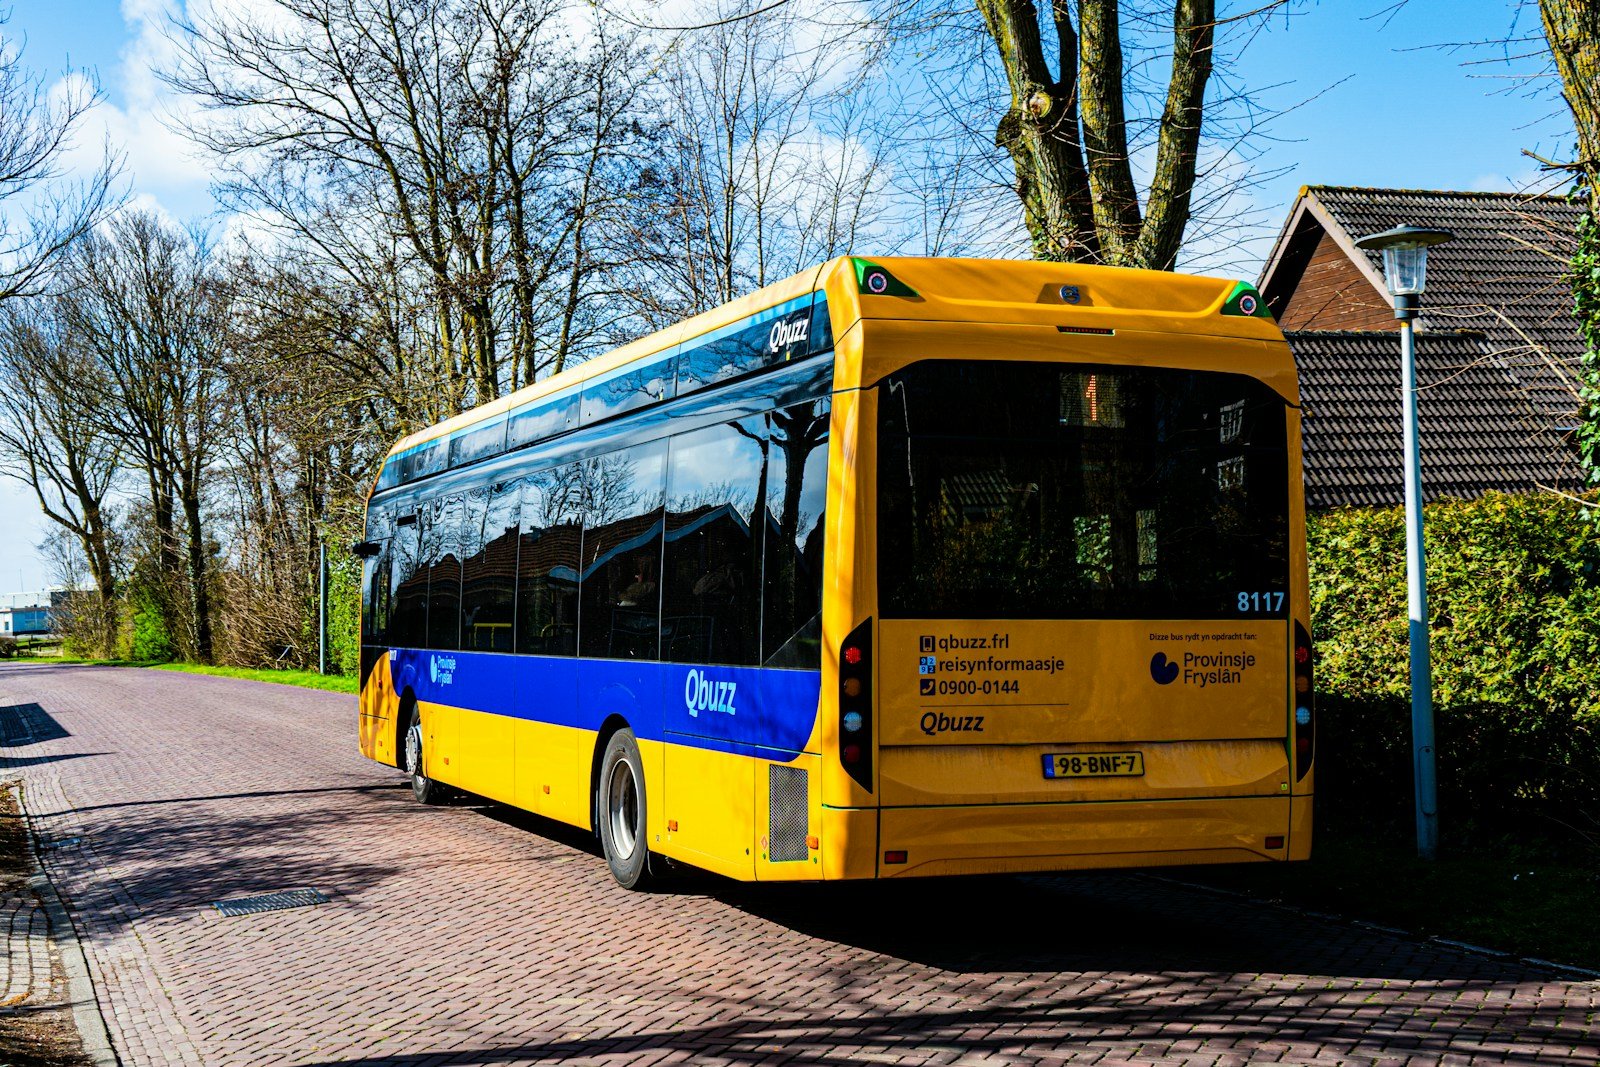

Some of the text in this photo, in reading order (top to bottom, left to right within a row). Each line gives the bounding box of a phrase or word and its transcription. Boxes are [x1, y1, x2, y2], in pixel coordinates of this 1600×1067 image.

[769, 319, 809, 353] Qbuzz
[1085, 375, 1097, 421] 1
[1237, 591, 1285, 612] 8117
[938, 634, 1009, 652] qbuzz.frl
[1149, 633, 1169, 641] Dizze
[1170, 633, 1184, 641] bus
[1185, 633, 1200, 642] rydt
[1201, 634, 1210, 642] yn
[1211, 633, 1242, 642] opdracht
[938, 656, 1065, 675] reisynformaasje
[1183, 651, 1256, 670] Provinsje
[938, 680, 1020, 695] 0900-0144
[1183, 668, 1241, 688] Fryslân
[685, 668, 737, 718] Qbuzz
[920, 711, 984, 736] Qbuzz
[1059, 756, 1136, 774] 98-BNF-7
